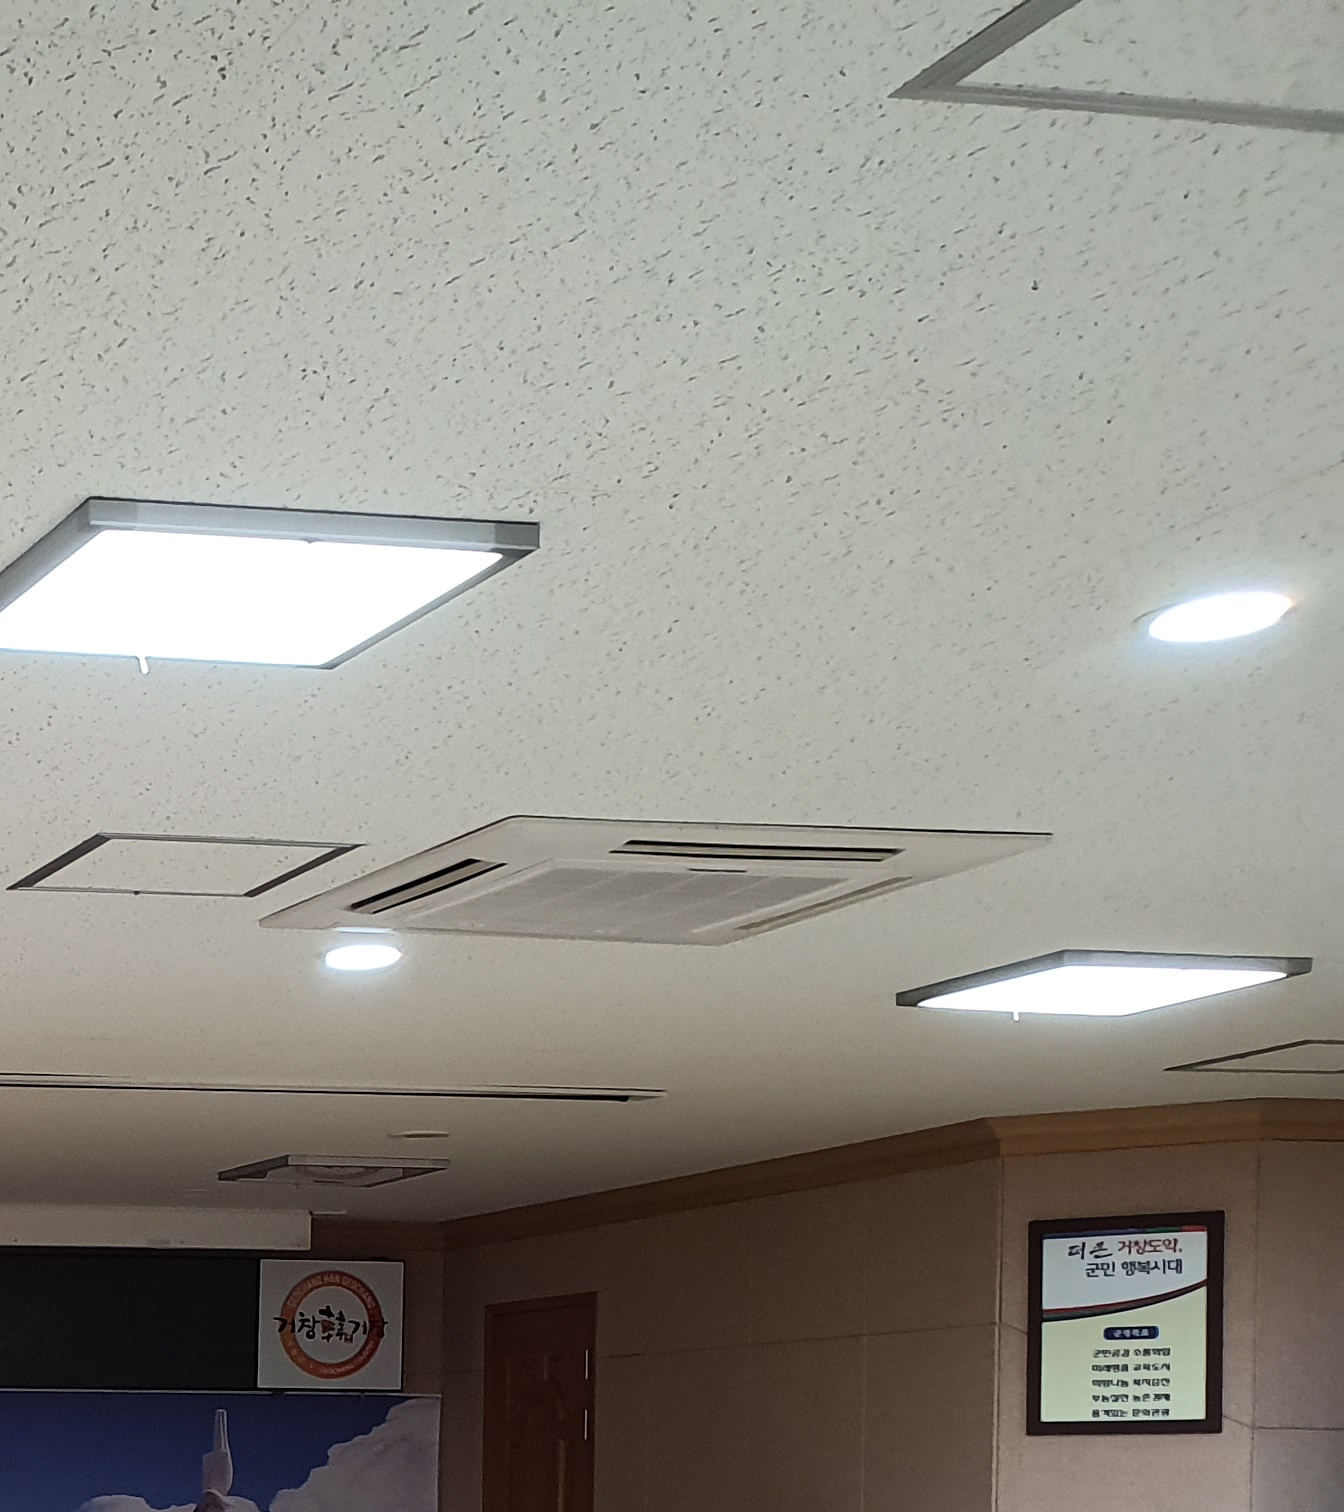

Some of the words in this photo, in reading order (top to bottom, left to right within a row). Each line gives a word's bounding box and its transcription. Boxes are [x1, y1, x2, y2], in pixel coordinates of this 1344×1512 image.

[1068, 1242, 1086, 1260] 더
[1089, 1241, 1113, 1259] 큰
[1085, 1260, 1116, 1277] 군민
[1121, 1258, 1182, 1276] 행복시대
